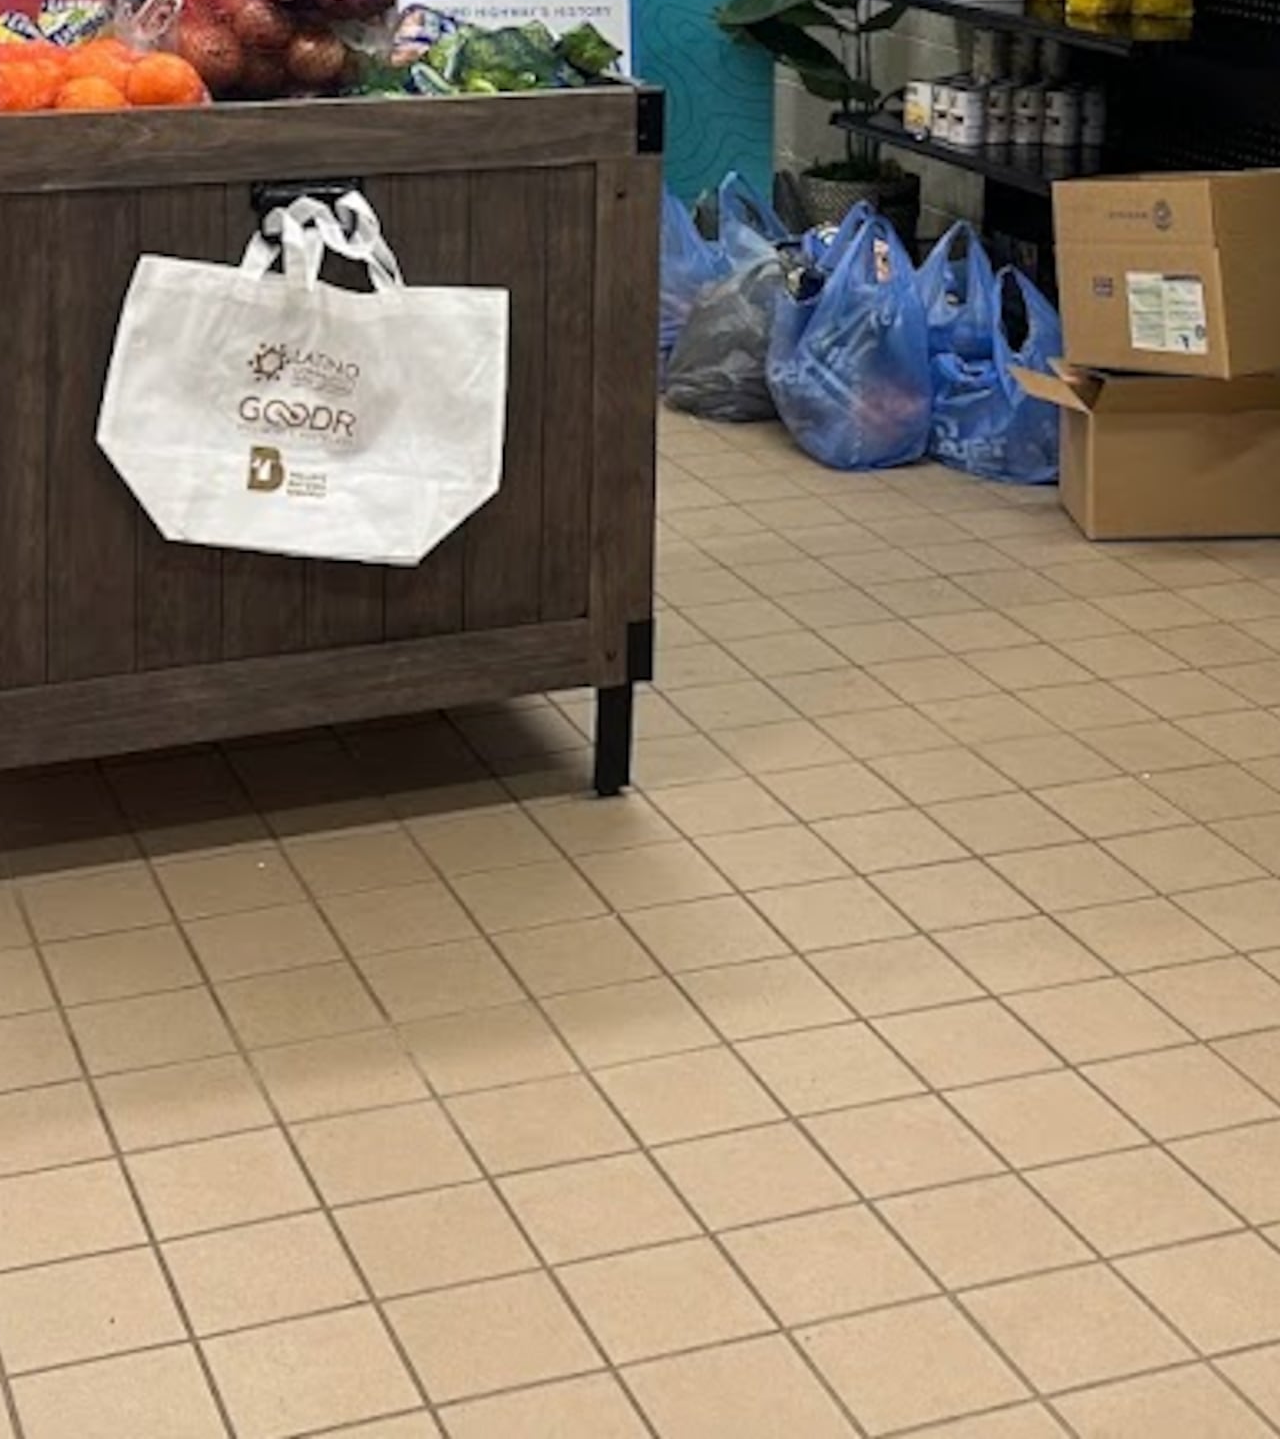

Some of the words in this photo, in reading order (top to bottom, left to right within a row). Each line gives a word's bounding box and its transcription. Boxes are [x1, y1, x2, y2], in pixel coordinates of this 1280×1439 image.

[554, 5, 613, 18] HISTORY
[294, 348, 360, 380] LATINO
[239, 396, 357, 437] GOODR
